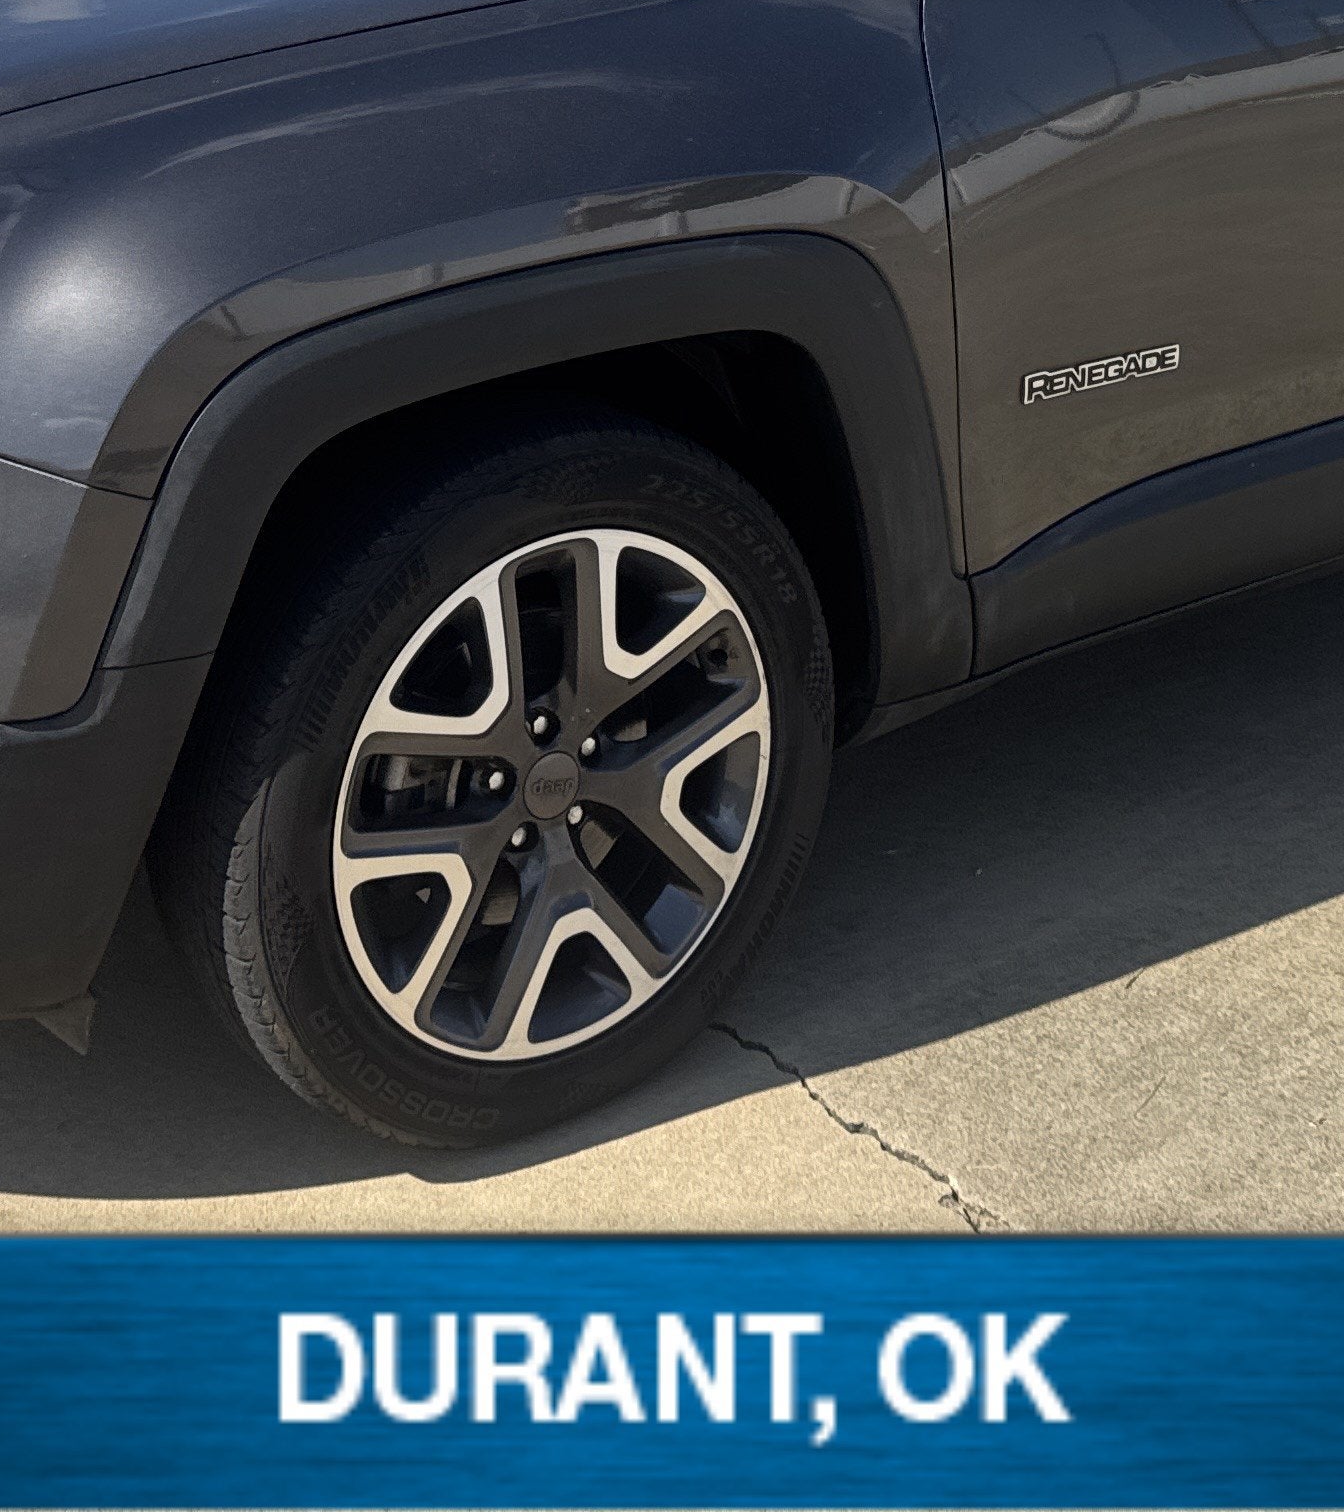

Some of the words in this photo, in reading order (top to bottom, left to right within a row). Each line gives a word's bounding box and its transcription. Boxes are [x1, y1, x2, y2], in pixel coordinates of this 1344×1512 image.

[1020, 344, 1180, 404] RENEGADE
[530, 777, 575, 797] Jeep
[306, 1002, 500, 1130] CROSSOVER
